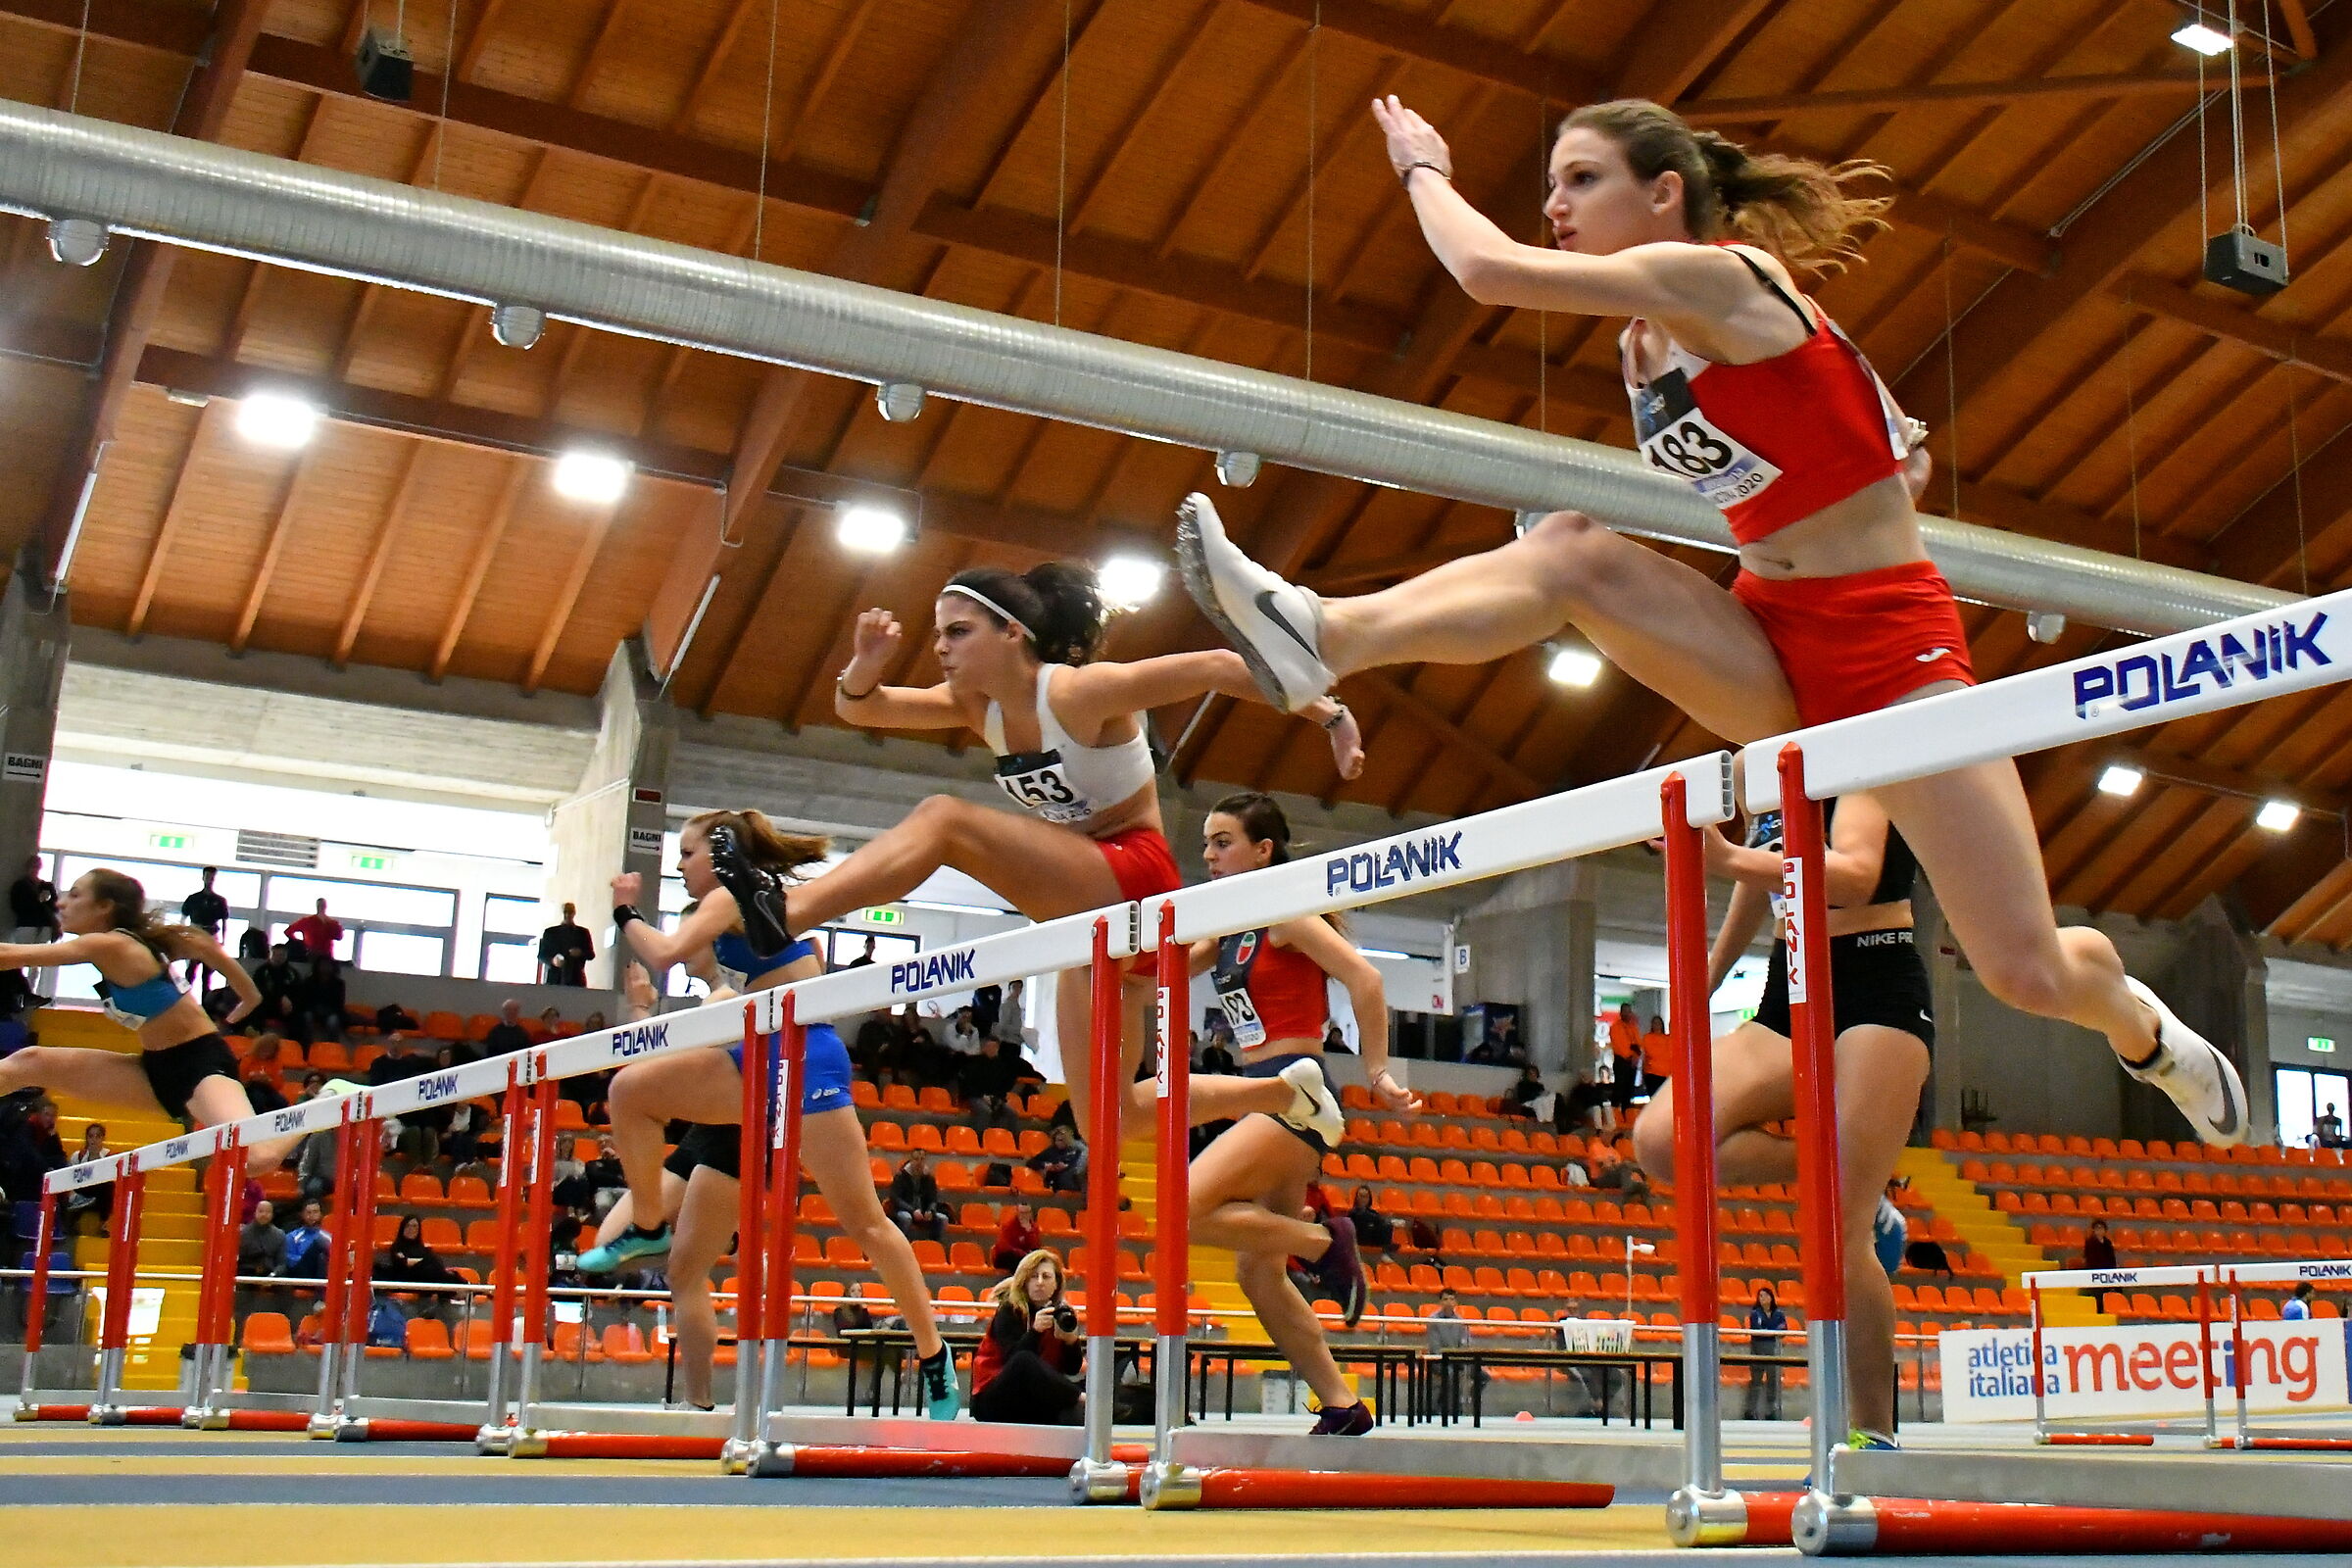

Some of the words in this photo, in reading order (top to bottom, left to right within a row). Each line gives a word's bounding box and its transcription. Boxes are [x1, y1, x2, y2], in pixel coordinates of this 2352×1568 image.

[1650, 420, 1733, 478] 183
[2073, 611, 2333, 720] POLANIK
[8, 757, 43, 769] BAGNI
[1004, 770, 1073, 808] 153
[632, 830, 662, 843] BAGNI
[1327, 830, 1463, 898] POLANIK
[1857, 932, 1896, 948] NIKE
[892, 948, 976, 995] POLANIK
[1459, 949, 1467, 965] B
[612, 1022, 669, 1056] POLANIK
[418, 1074, 459, 1102] POLANIK
[2091, 1272, 2137, 1284] POLANIK
[2299, 1265, 2351, 1277] POLANIK
[1969, 1338, 2058, 1368] atletia
